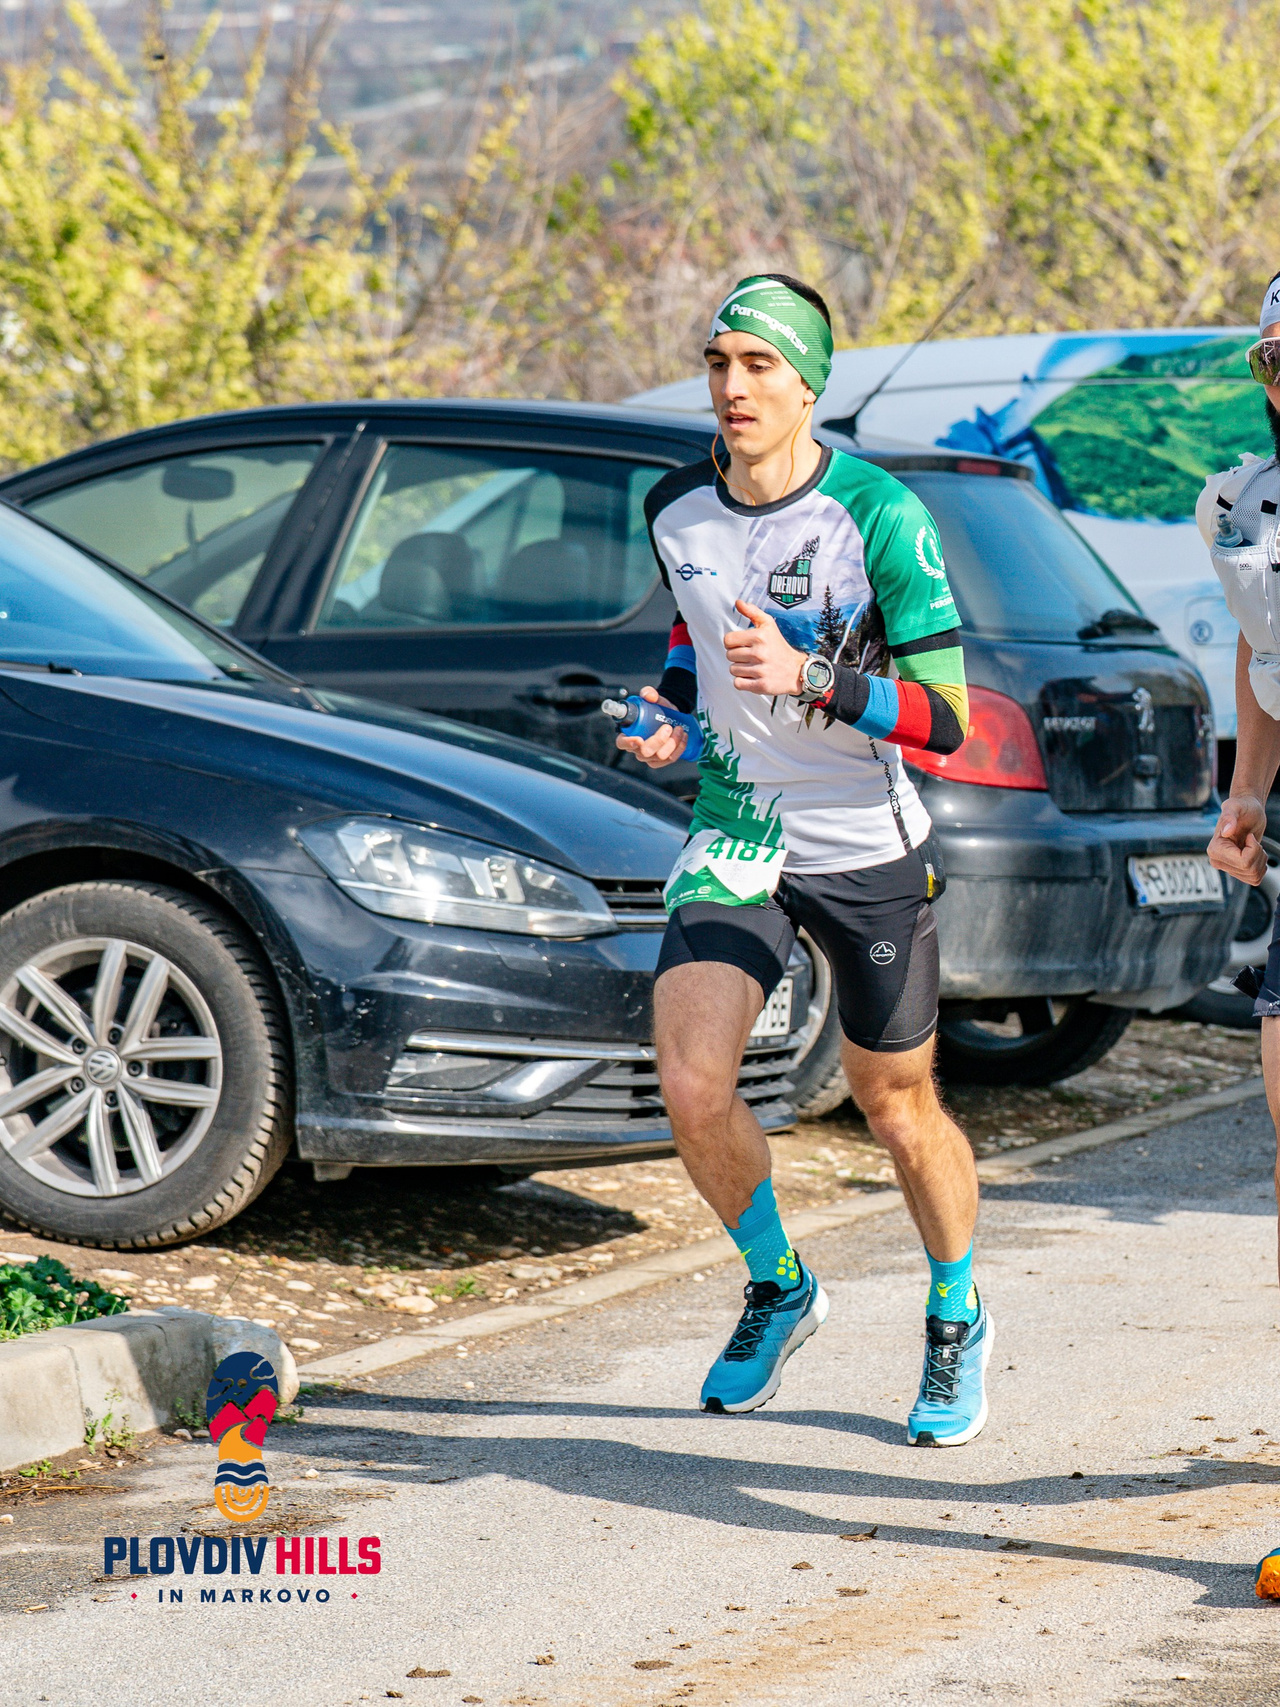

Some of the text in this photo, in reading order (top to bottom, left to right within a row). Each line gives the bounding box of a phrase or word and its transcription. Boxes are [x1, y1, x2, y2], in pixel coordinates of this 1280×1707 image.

[730, 303, 809, 356] Parangalitsa
[770, 574, 809, 596] OREHOVO
[705, 837, 779, 863] 4187
